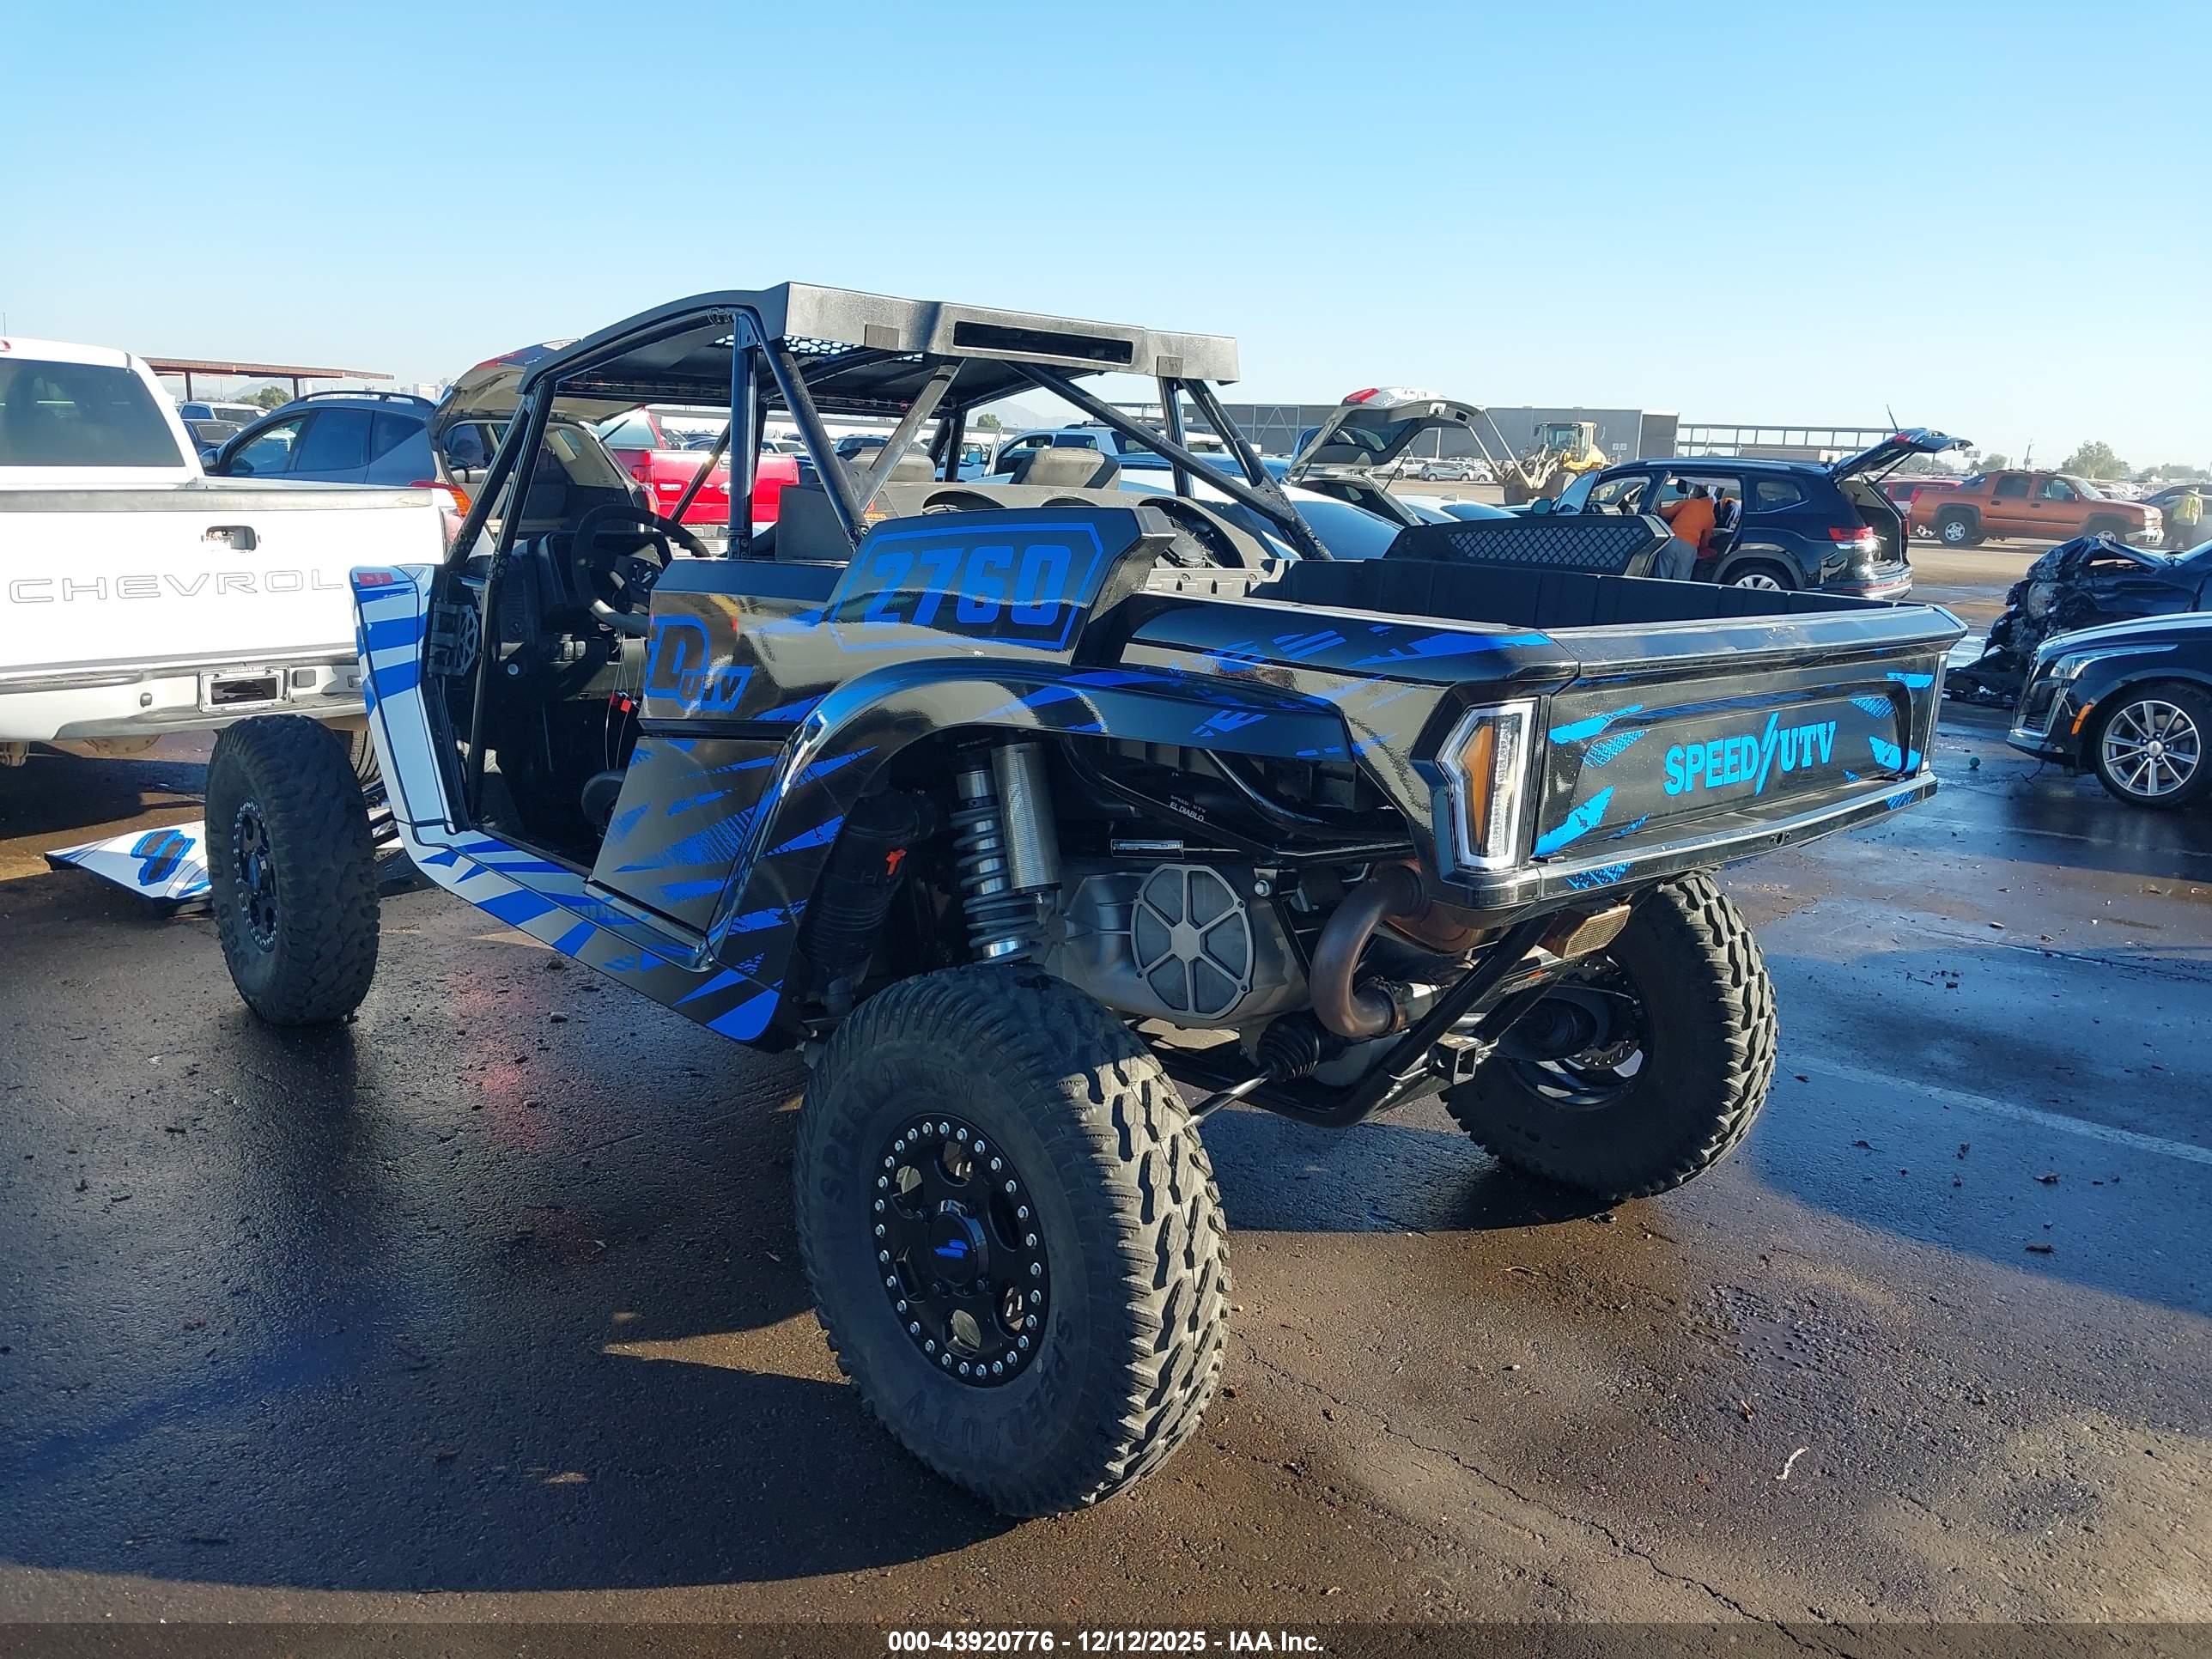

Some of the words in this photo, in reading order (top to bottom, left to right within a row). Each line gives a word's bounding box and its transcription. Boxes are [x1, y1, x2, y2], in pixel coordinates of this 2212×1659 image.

[863, 544, 1073, 630] 2760
[1170, 801, 1179, 811] EL
[1178, 805, 1205, 822] DIABLO
